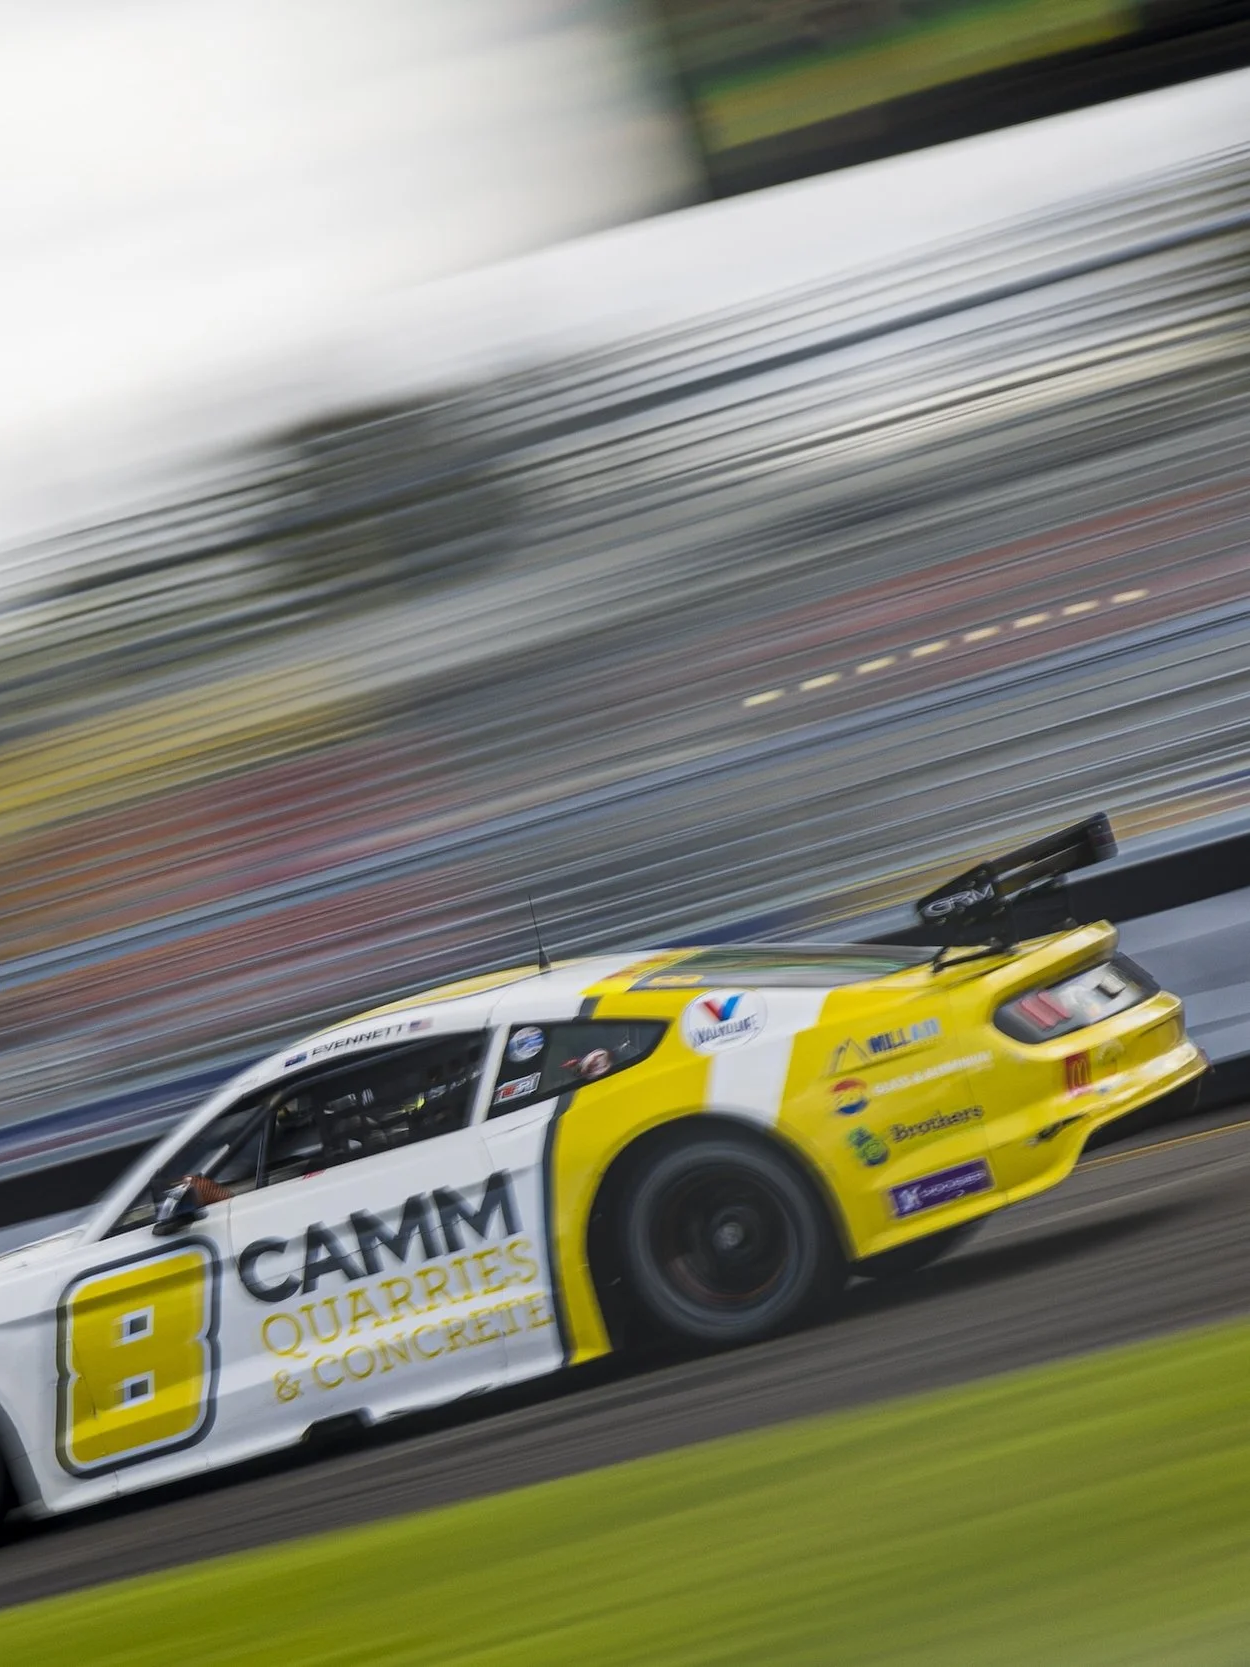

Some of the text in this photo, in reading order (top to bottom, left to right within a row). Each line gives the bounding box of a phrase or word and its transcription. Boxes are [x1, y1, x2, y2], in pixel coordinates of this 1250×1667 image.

[922, 882, 996, 917] GRM
[311, 1022, 407, 1056] EVENNETT
[889, 1104, 984, 1143] Brothers
[238, 1168, 524, 1302] CAMM
[260, 1238, 540, 1359] QUARRIES
[273, 1292, 555, 1401] & CONCRETE
[62, 1244, 215, 1470] 8
